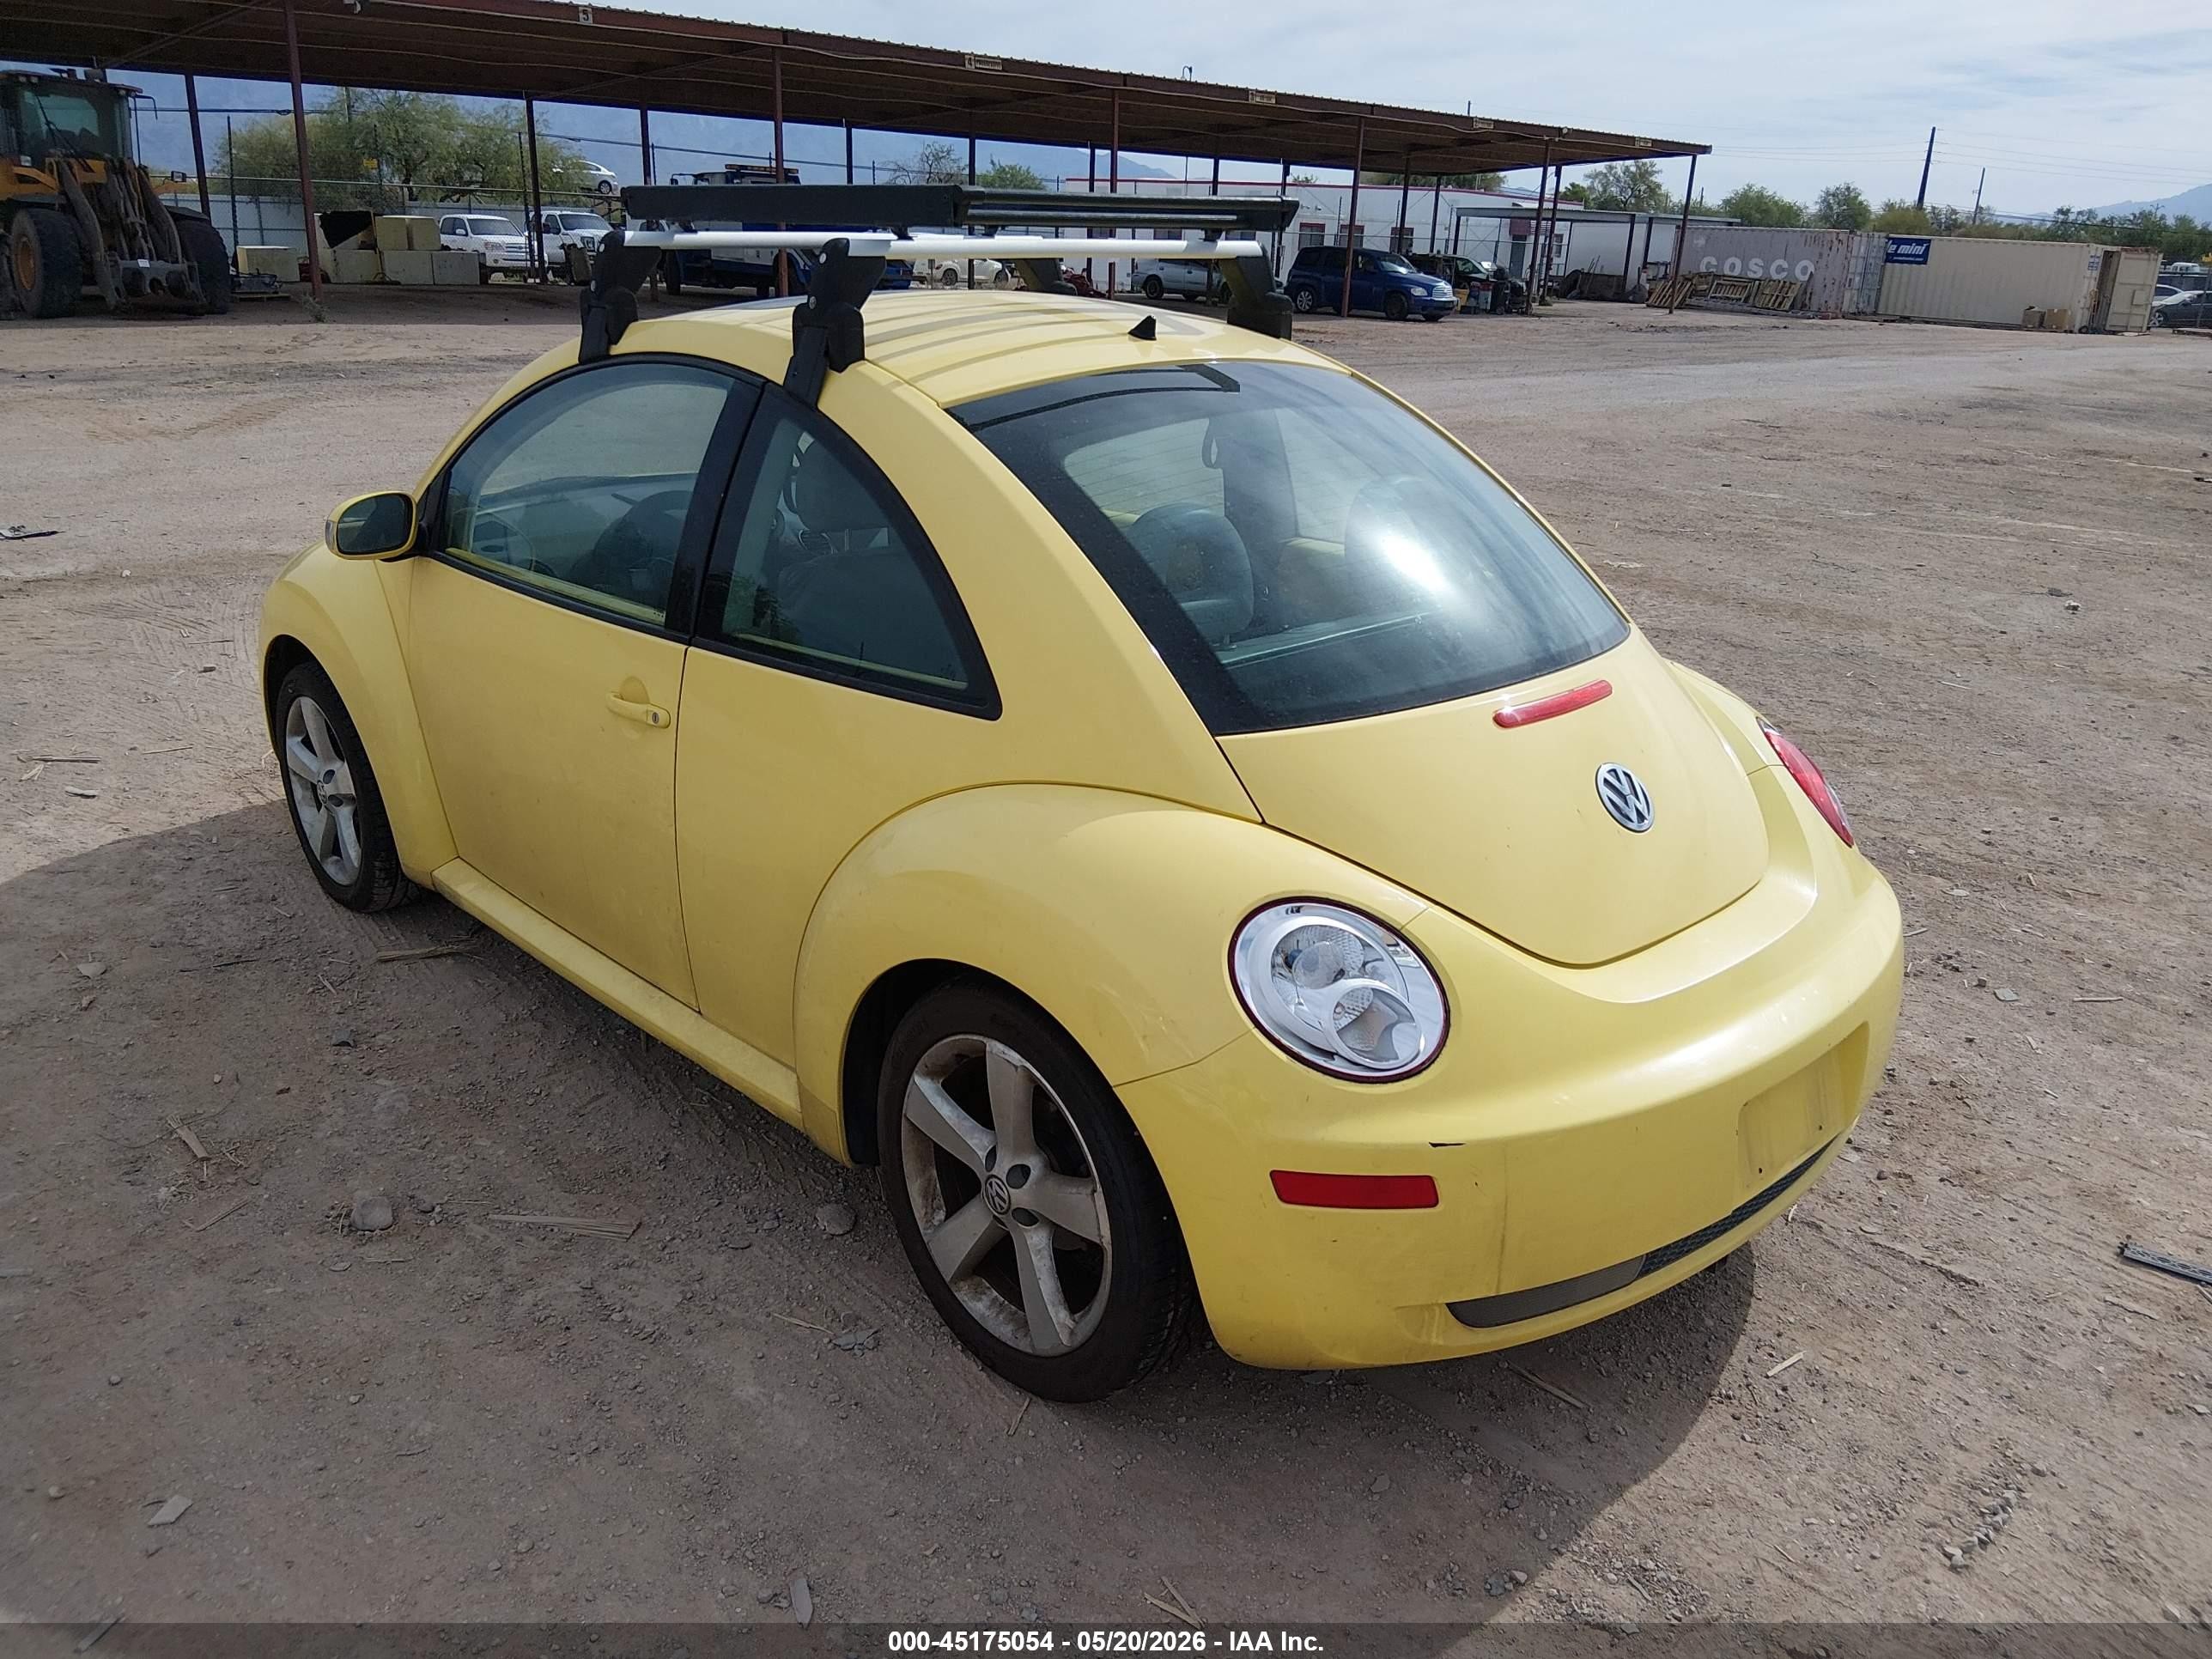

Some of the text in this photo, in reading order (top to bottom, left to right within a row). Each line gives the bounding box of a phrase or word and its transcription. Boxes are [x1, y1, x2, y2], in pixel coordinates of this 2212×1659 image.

[582, 9, 589, 21] 5
[1897, 243, 1929, 255] mini
[1699, 256, 1815, 282] COSCO
